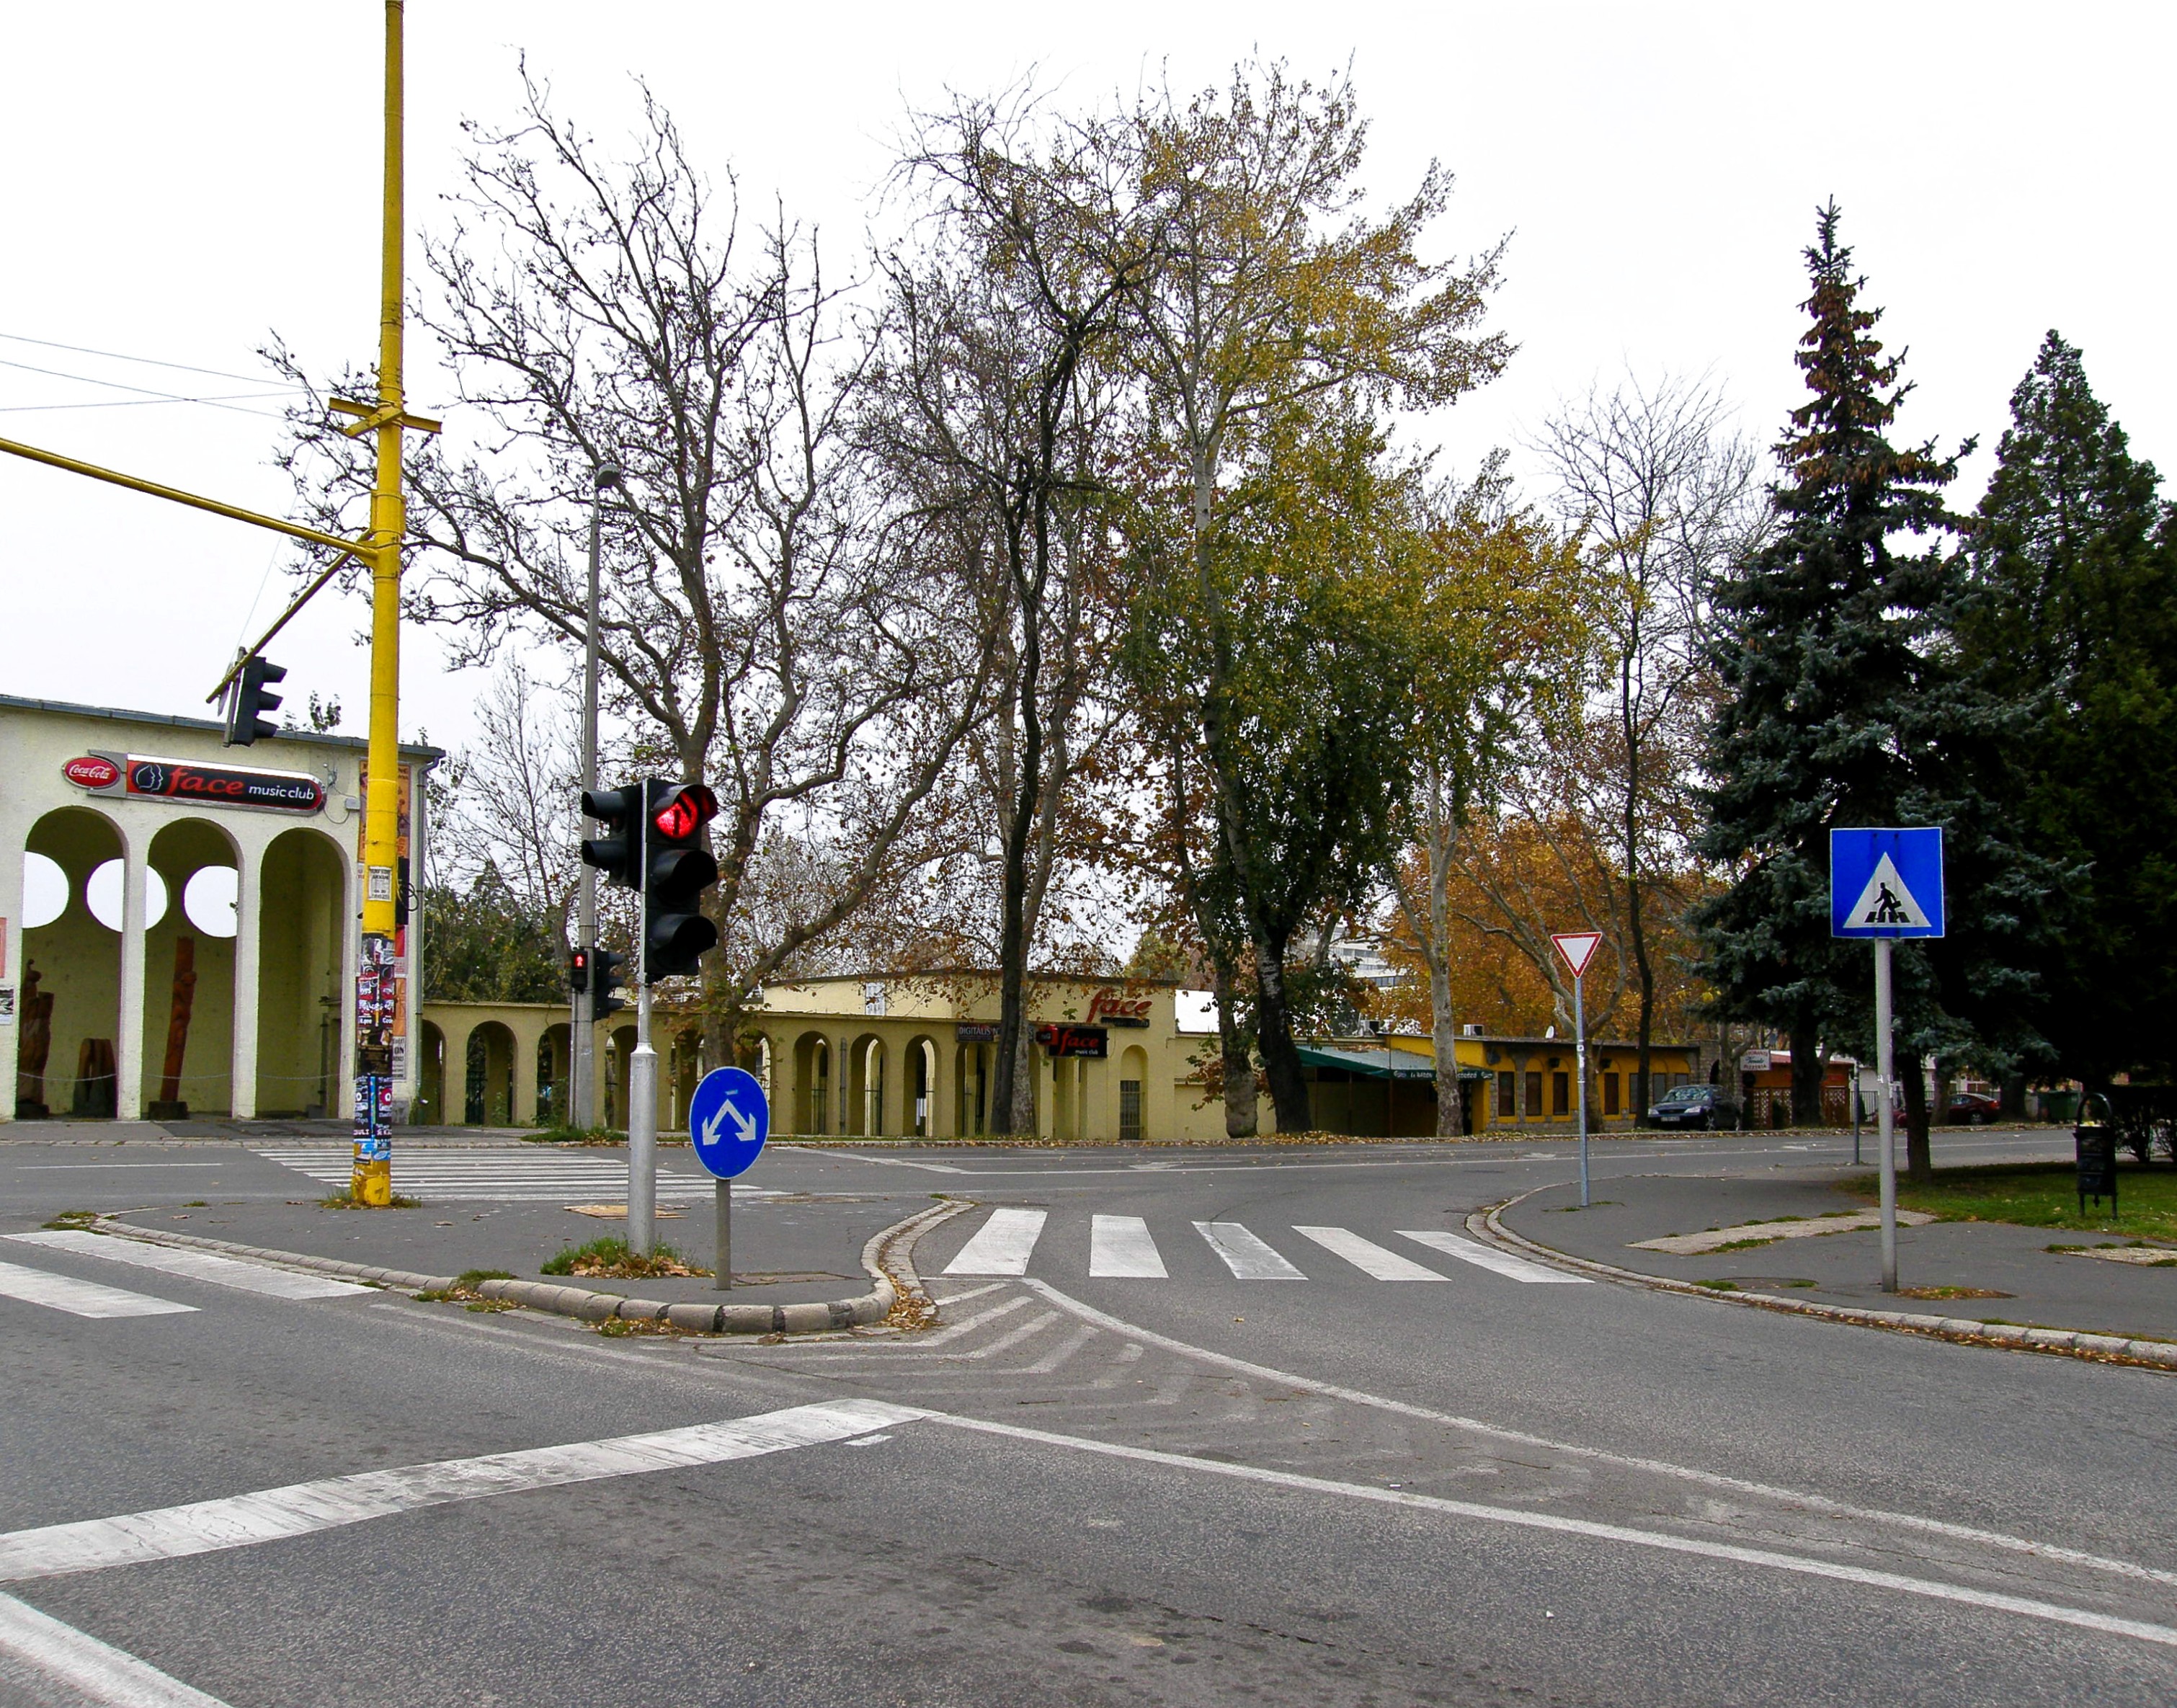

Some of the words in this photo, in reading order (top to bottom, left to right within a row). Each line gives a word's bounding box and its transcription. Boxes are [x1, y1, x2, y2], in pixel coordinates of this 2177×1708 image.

[168, 765, 244, 795] face
[249, 784, 286, 798] music
[288, 786, 314, 800] club
[1086, 987, 1152, 1023] face
[1059, 1028, 1099, 1056] face
